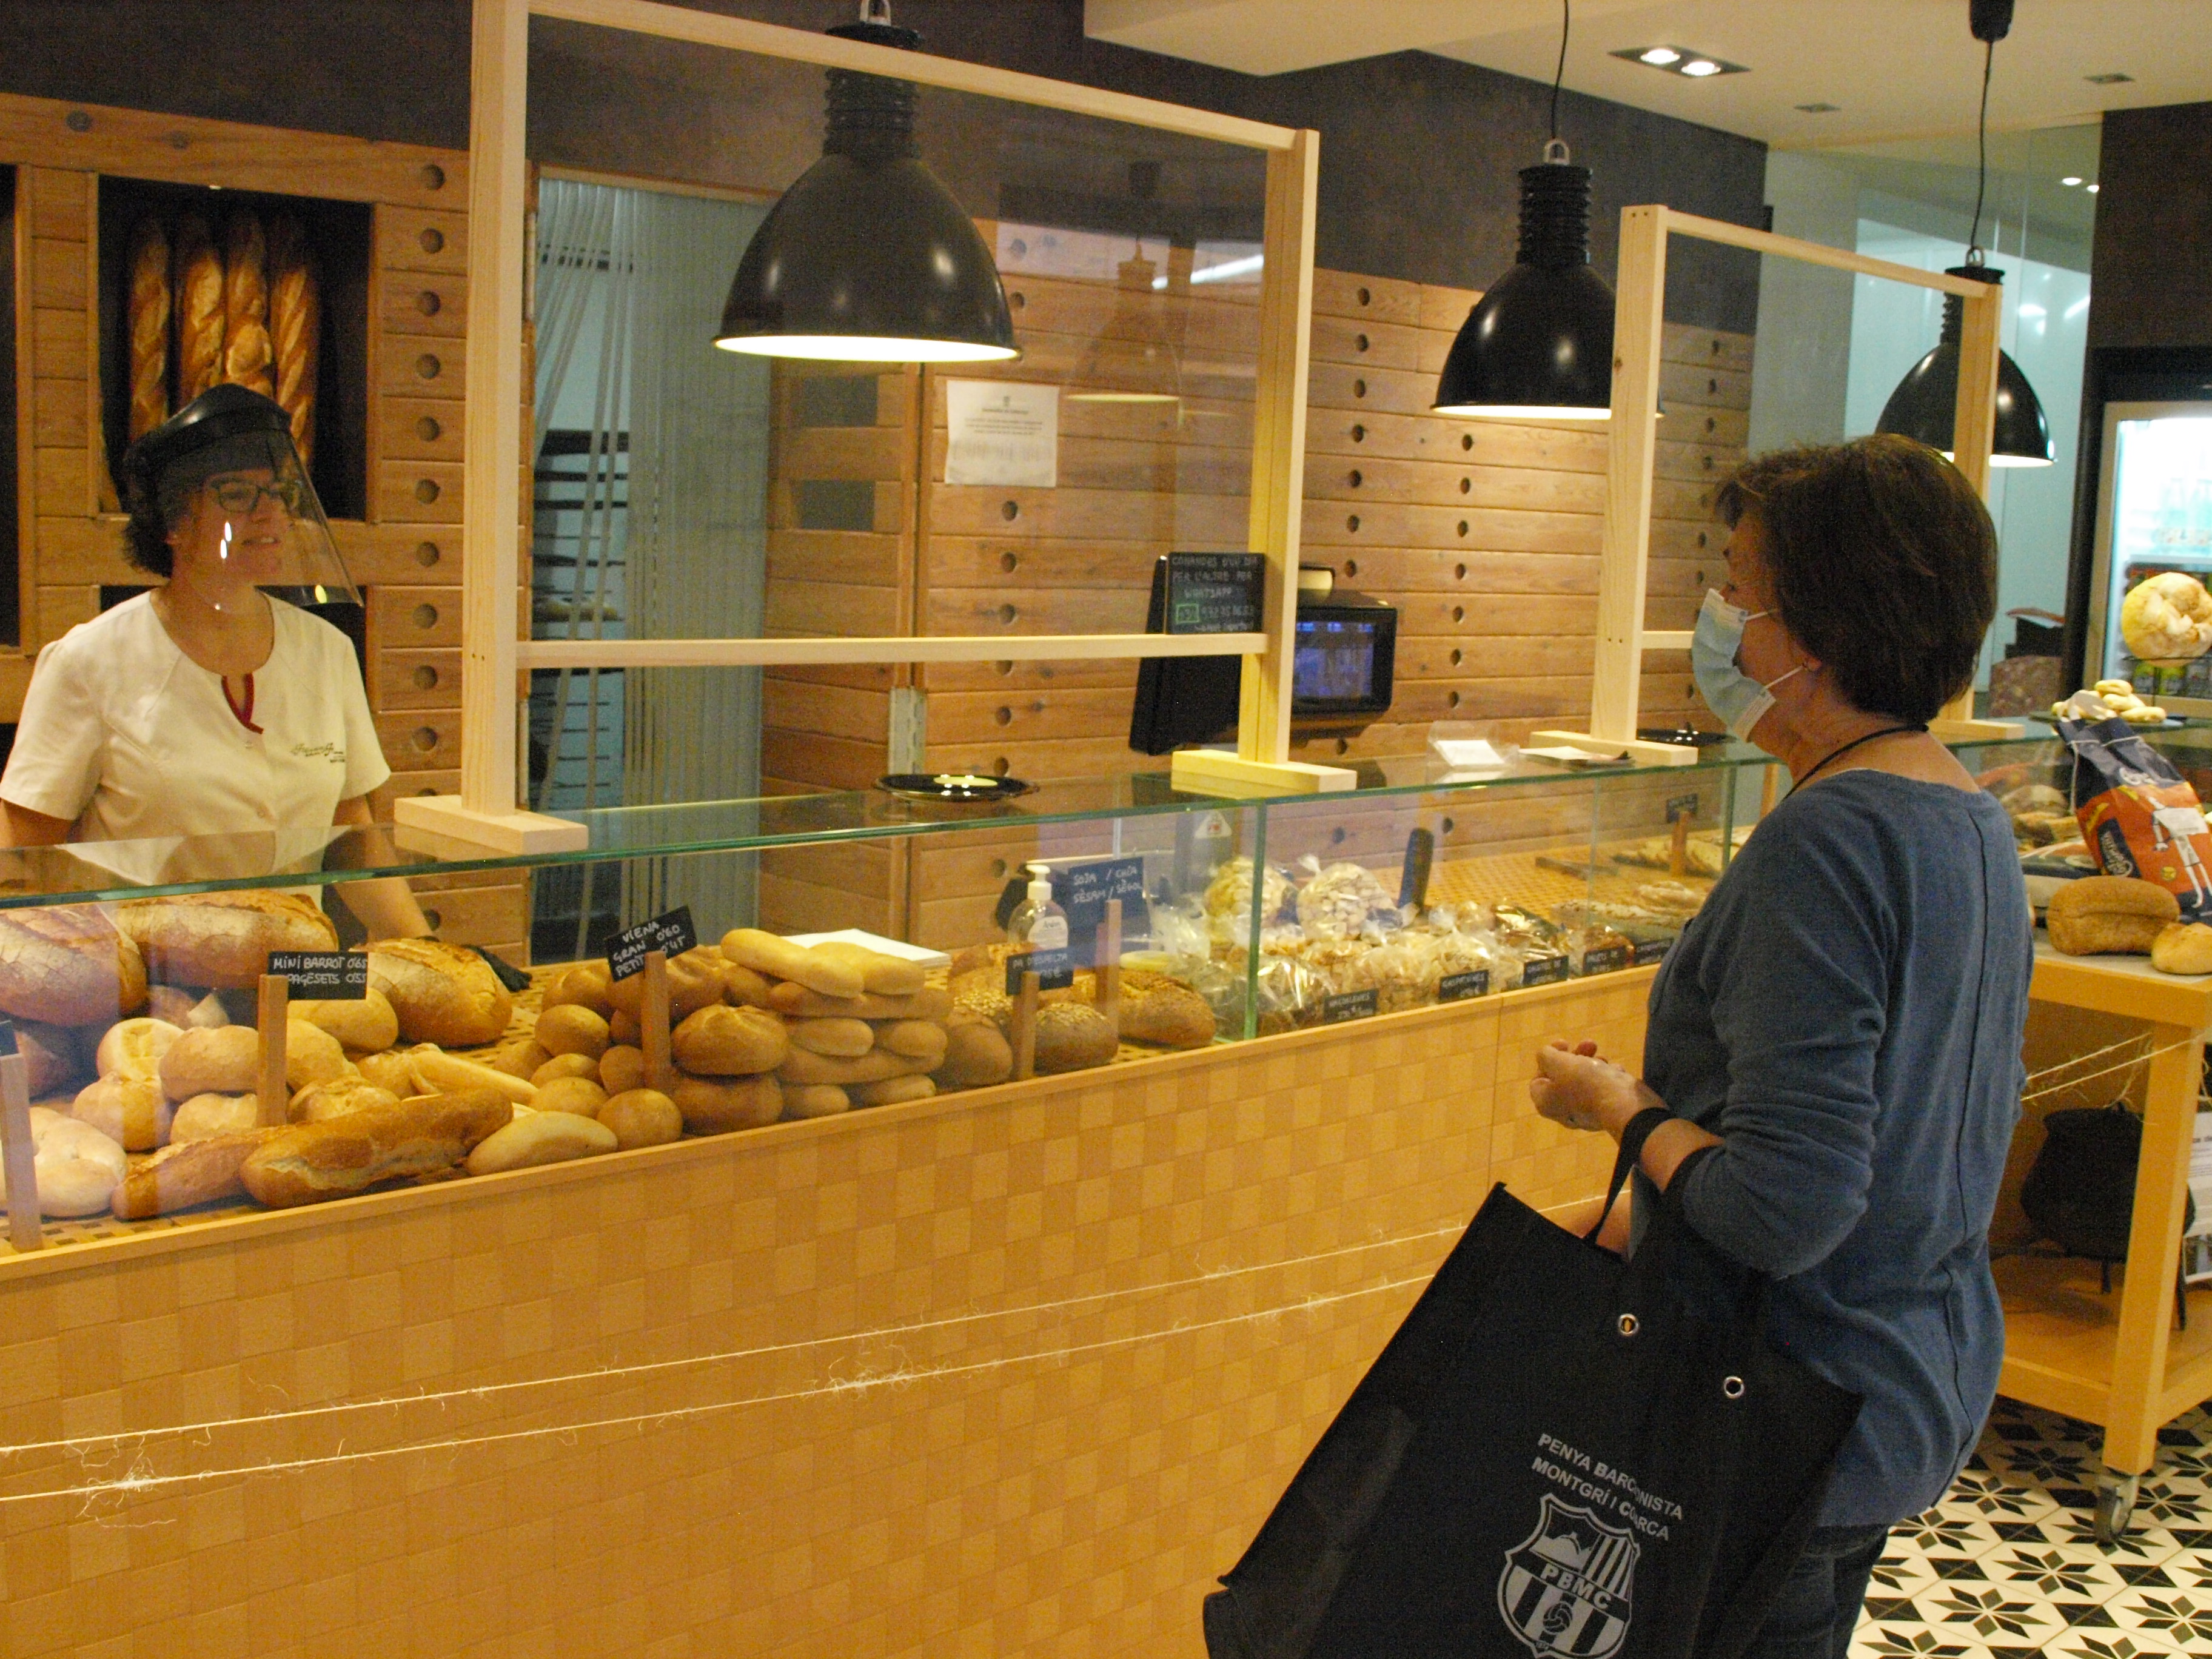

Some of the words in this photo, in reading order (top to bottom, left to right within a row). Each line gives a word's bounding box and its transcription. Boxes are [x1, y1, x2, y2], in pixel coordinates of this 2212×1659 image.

[622, 921, 660, 943] VIENA
[303, 956, 346, 970] BARROT
[612, 940, 646, 963] GRAN
[1537, 1433, 1591, 1471] PENYA
[1531, 1456, 1611, 1506] MONTGRÍ
[1540, 1563, 1613, 1610] PBMC
